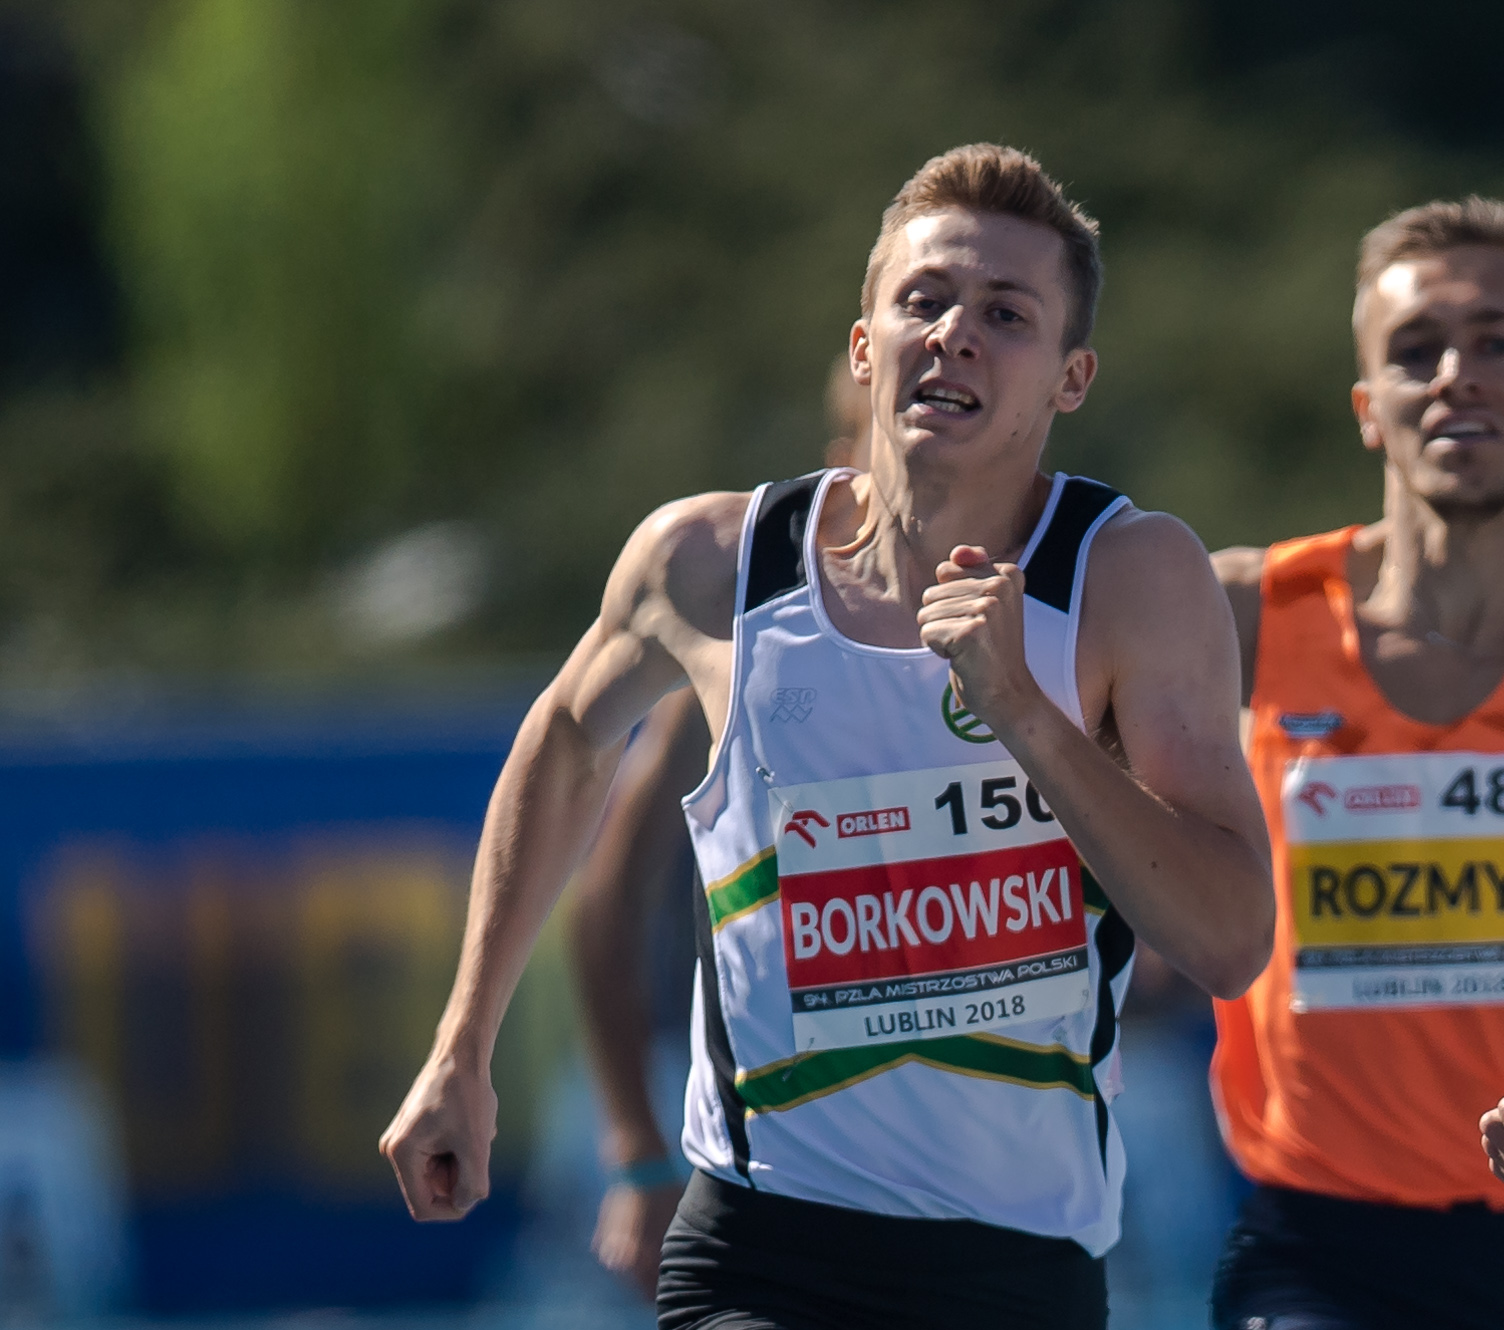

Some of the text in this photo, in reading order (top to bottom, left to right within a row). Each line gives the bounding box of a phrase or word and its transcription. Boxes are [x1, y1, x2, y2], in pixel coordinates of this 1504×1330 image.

[840, 810, 905, 835] ORLEN
[790, 866, 1072, 960] BORKOWSKI
[835, 987, 883, 1004] PZLA
[885, 968, 1016, 997] MISTRZOSTWA
[1016, 954, 1078, 979] POLSKI
[865, 995, 1026, 1038] LUBLIN 2018
